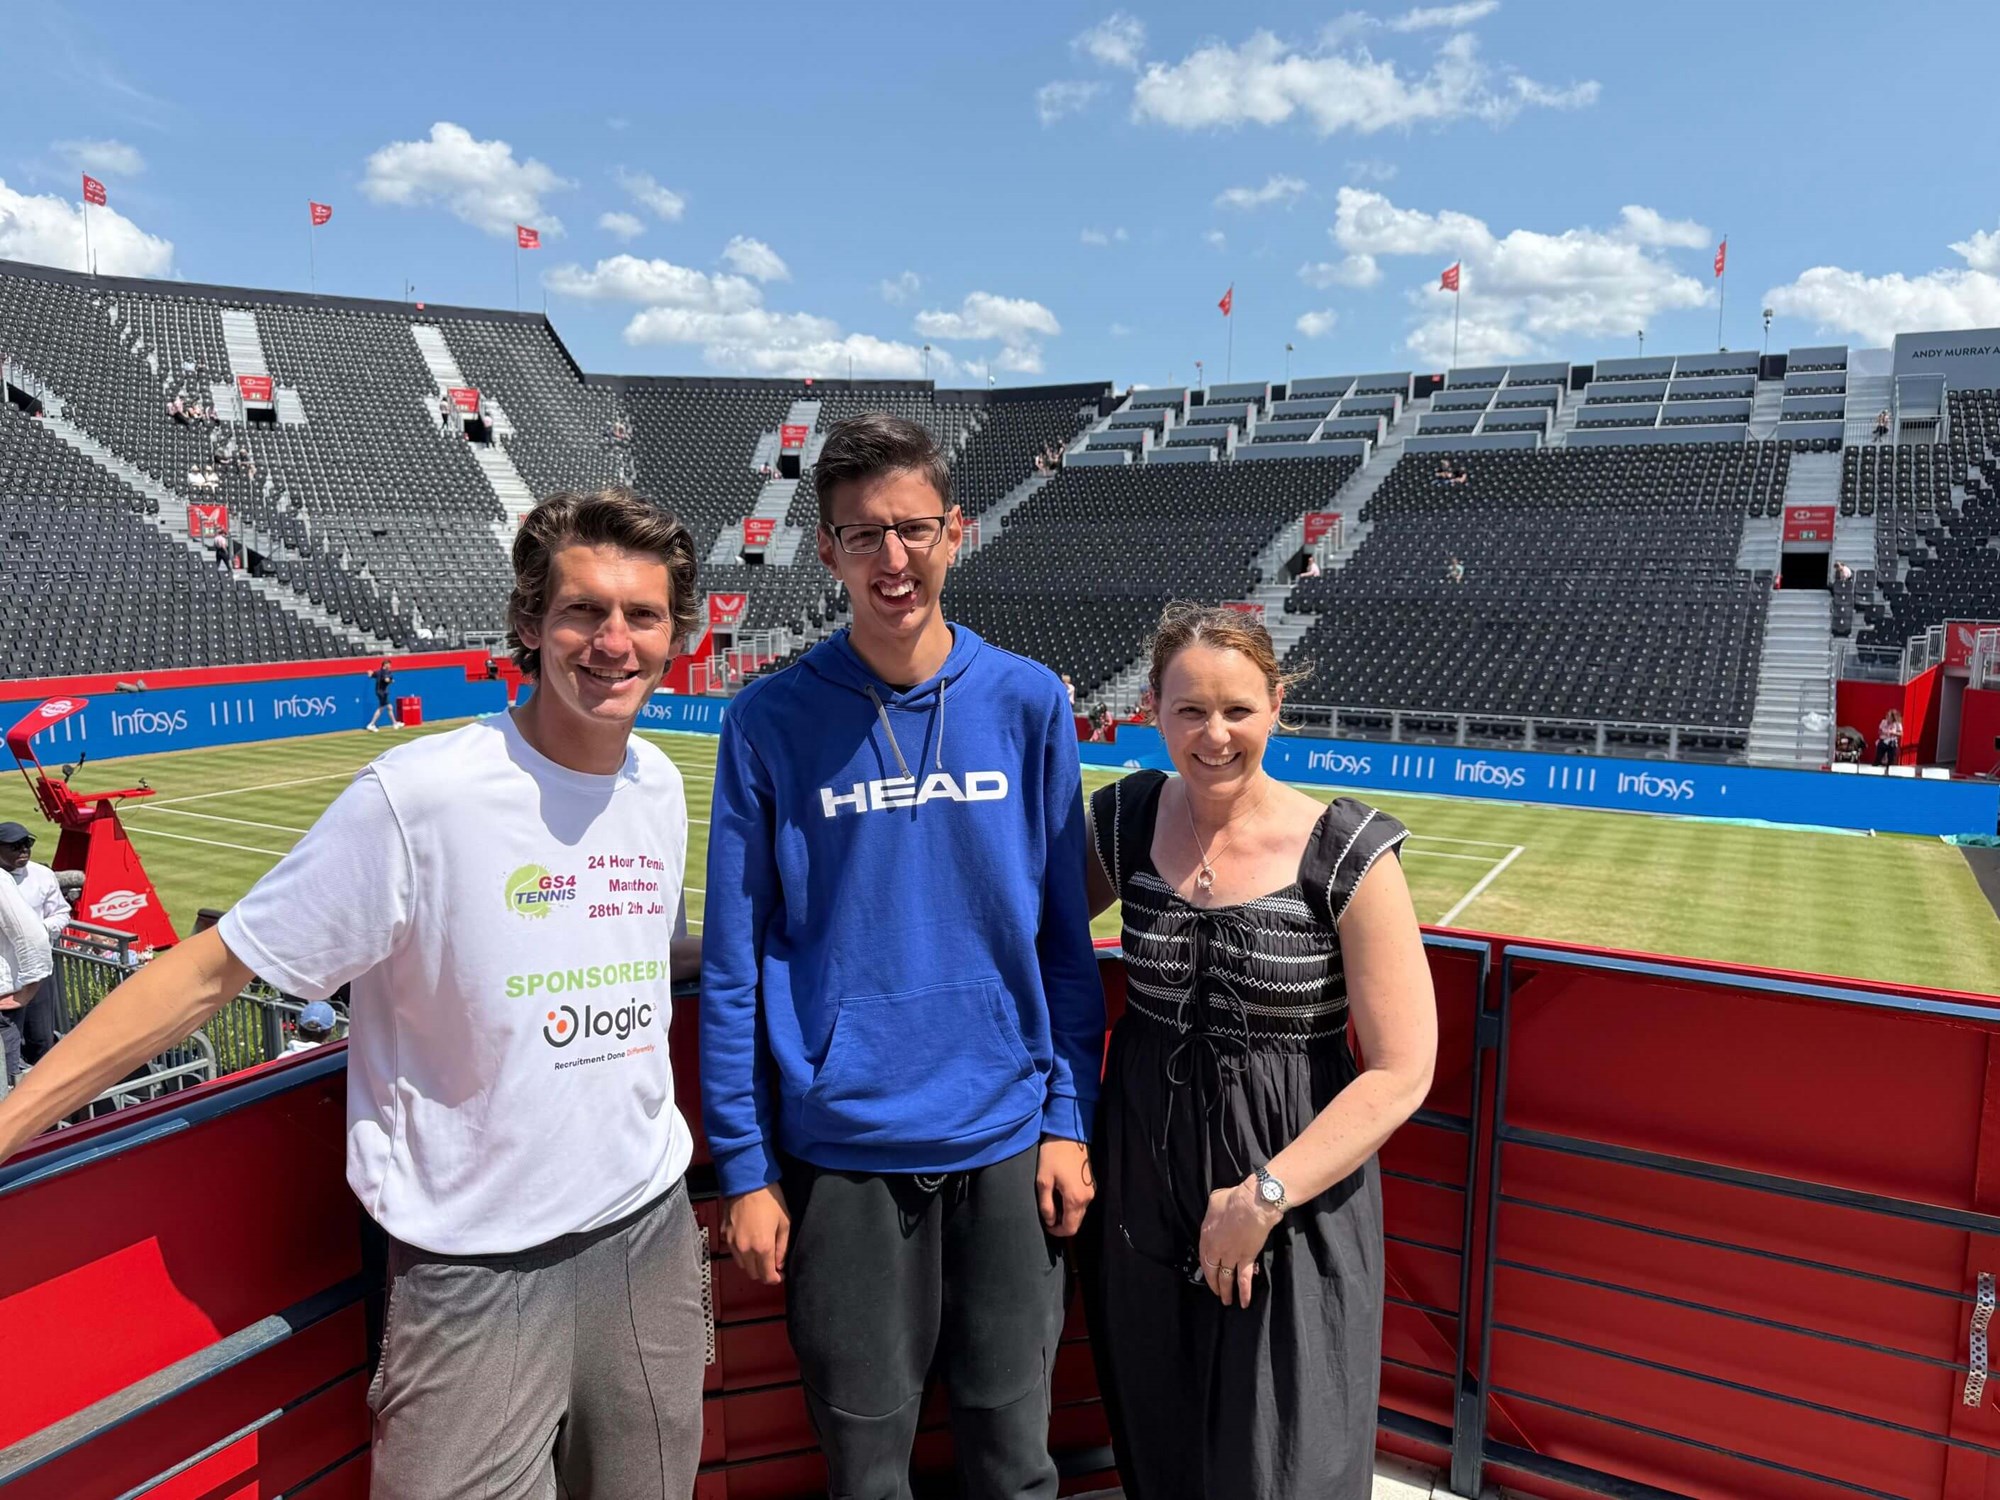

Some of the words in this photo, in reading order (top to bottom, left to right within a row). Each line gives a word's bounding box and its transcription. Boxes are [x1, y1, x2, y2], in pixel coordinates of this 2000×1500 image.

[1911, 349, 1942, 359] ANDY
[1944, 346, 1991, 357] MURRAY
[274, 694, 337, 720] Infosys
[112, 708, 188, 736] Infosys
[1308, 750, 1371, 775] Infosys
[1455, 759, 1525, 789] Infosys
[820, 771, 1009, 817] HEAD
[1618, 772, 1695, 800] Infosys
[588, 855, 605, 869] 24
[609, 855, 634, 868] Hour
[538, 875, 576, 890] GS4
[515, 888, 576, 904] TENNIS
[588, 901, 623, 918] 28th/
[585, 998, 652, 1040] logic
[554, 1055, 606, 1070] Recruitment
[607, 1051, 626, 1061] Done
